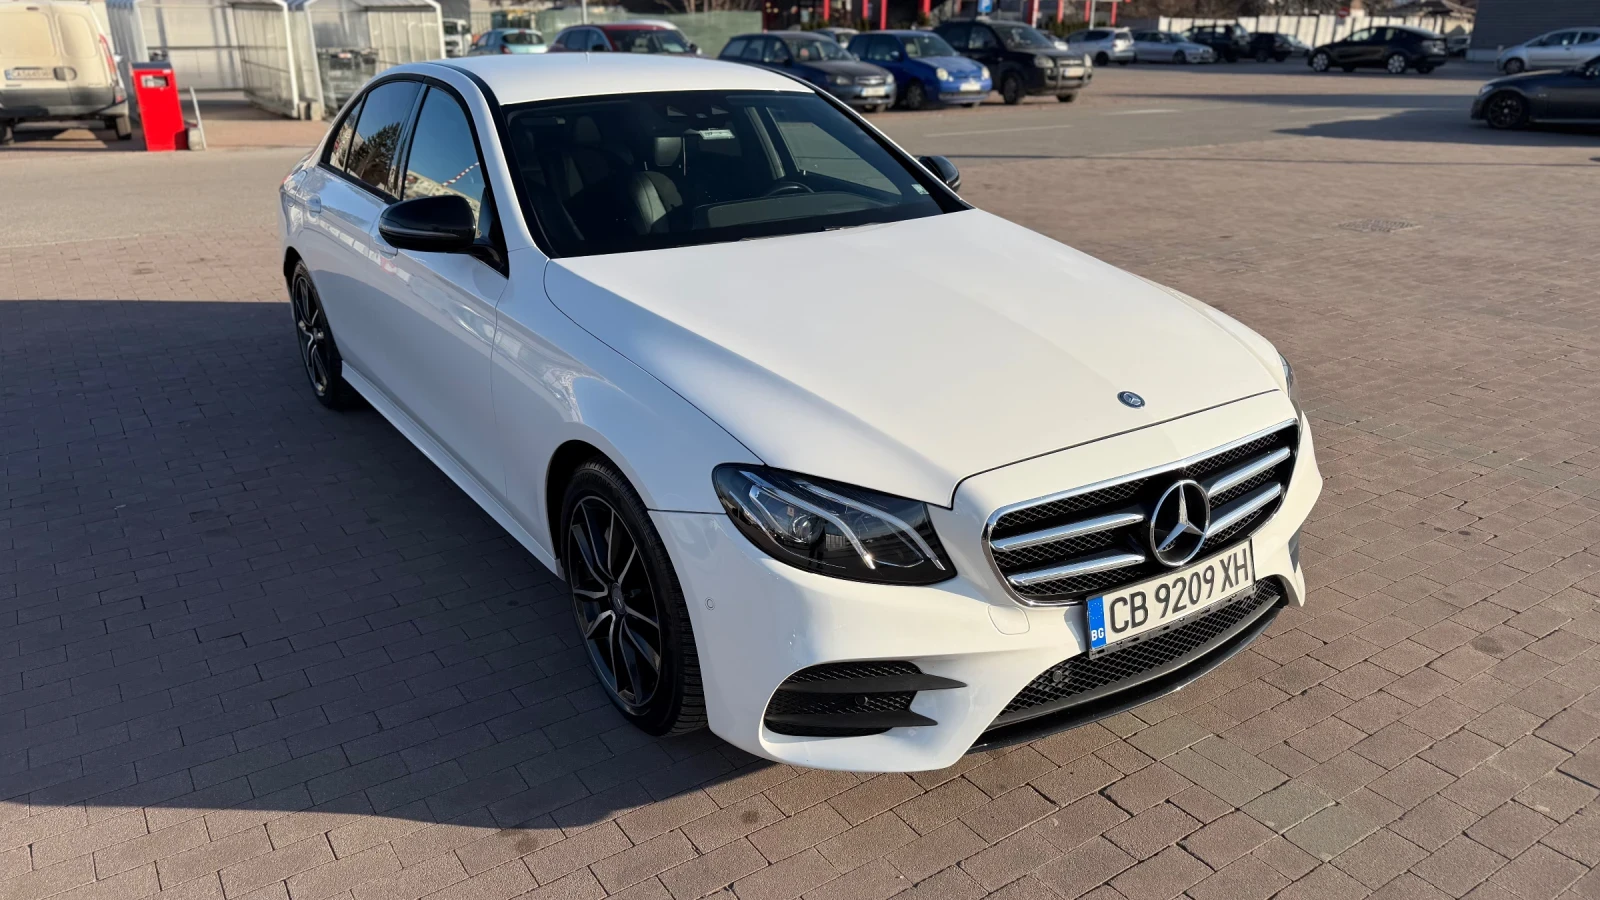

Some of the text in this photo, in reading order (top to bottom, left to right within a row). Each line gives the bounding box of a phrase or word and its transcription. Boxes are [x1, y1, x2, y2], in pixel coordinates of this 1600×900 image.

[1109, 548, 1249, 634] CB 9209 XH
[1091, 627, 1105, 641] BG
